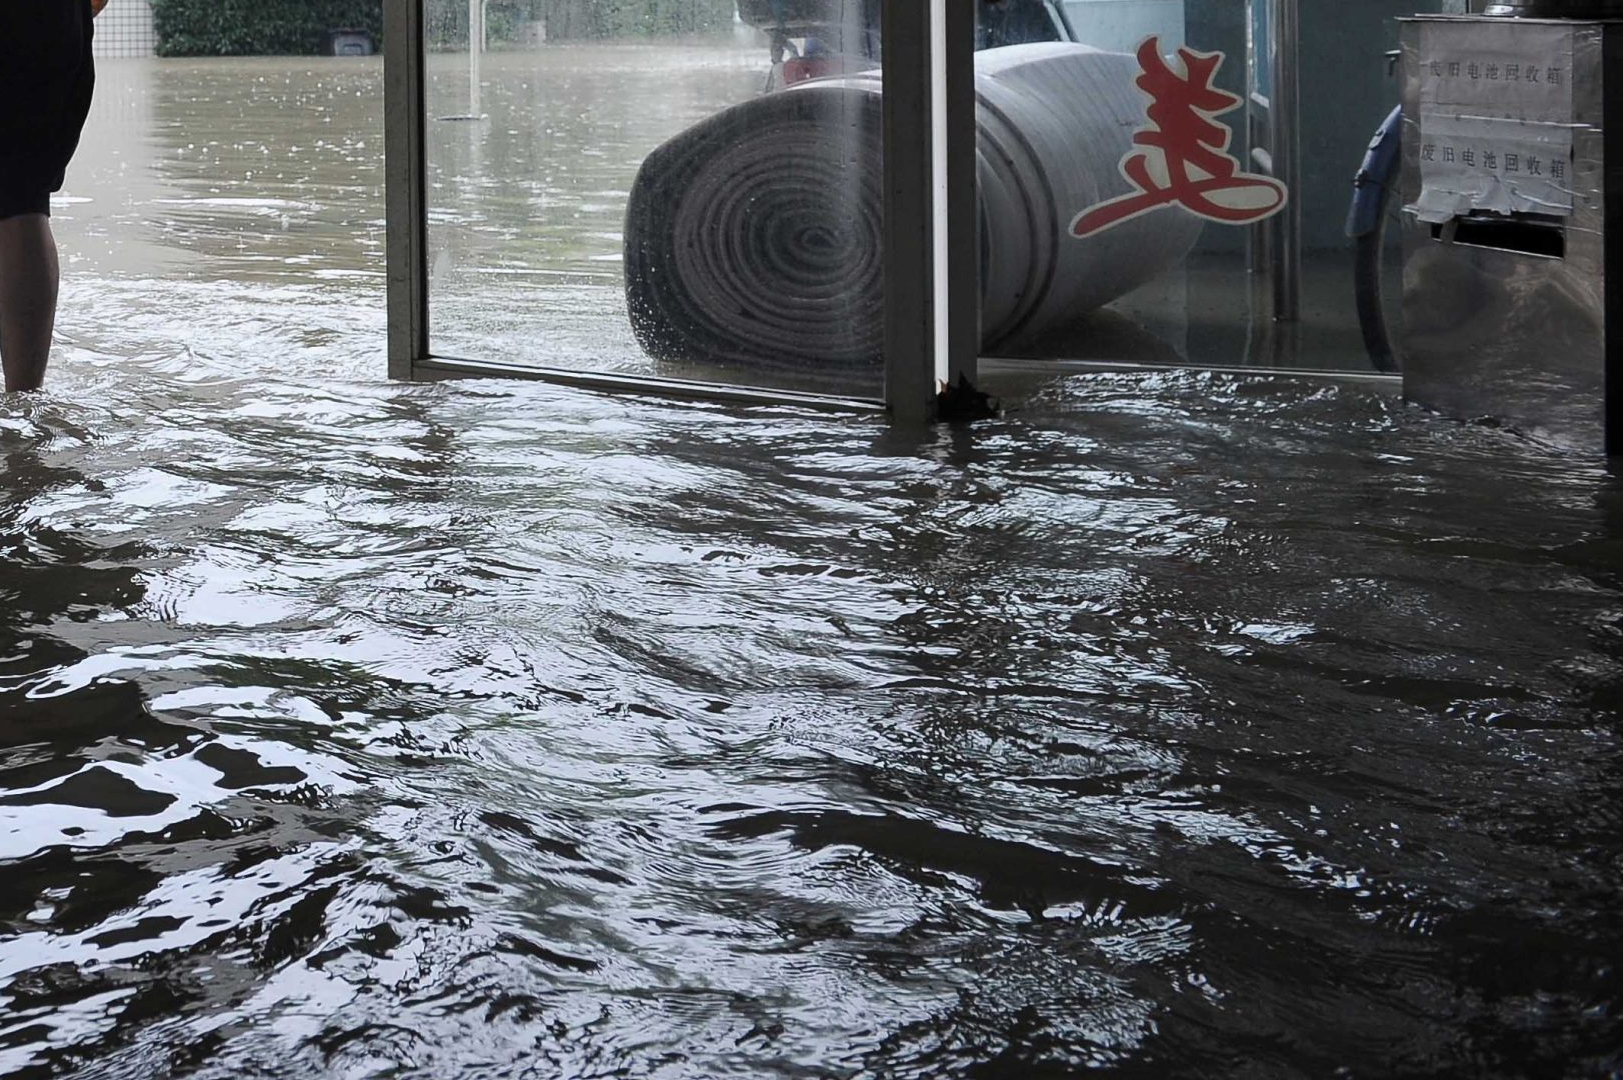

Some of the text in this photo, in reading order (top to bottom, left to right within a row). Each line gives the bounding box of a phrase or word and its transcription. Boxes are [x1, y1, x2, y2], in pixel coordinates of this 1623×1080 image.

[1421, 143, 1566, 179] 废旧电池回收箱
